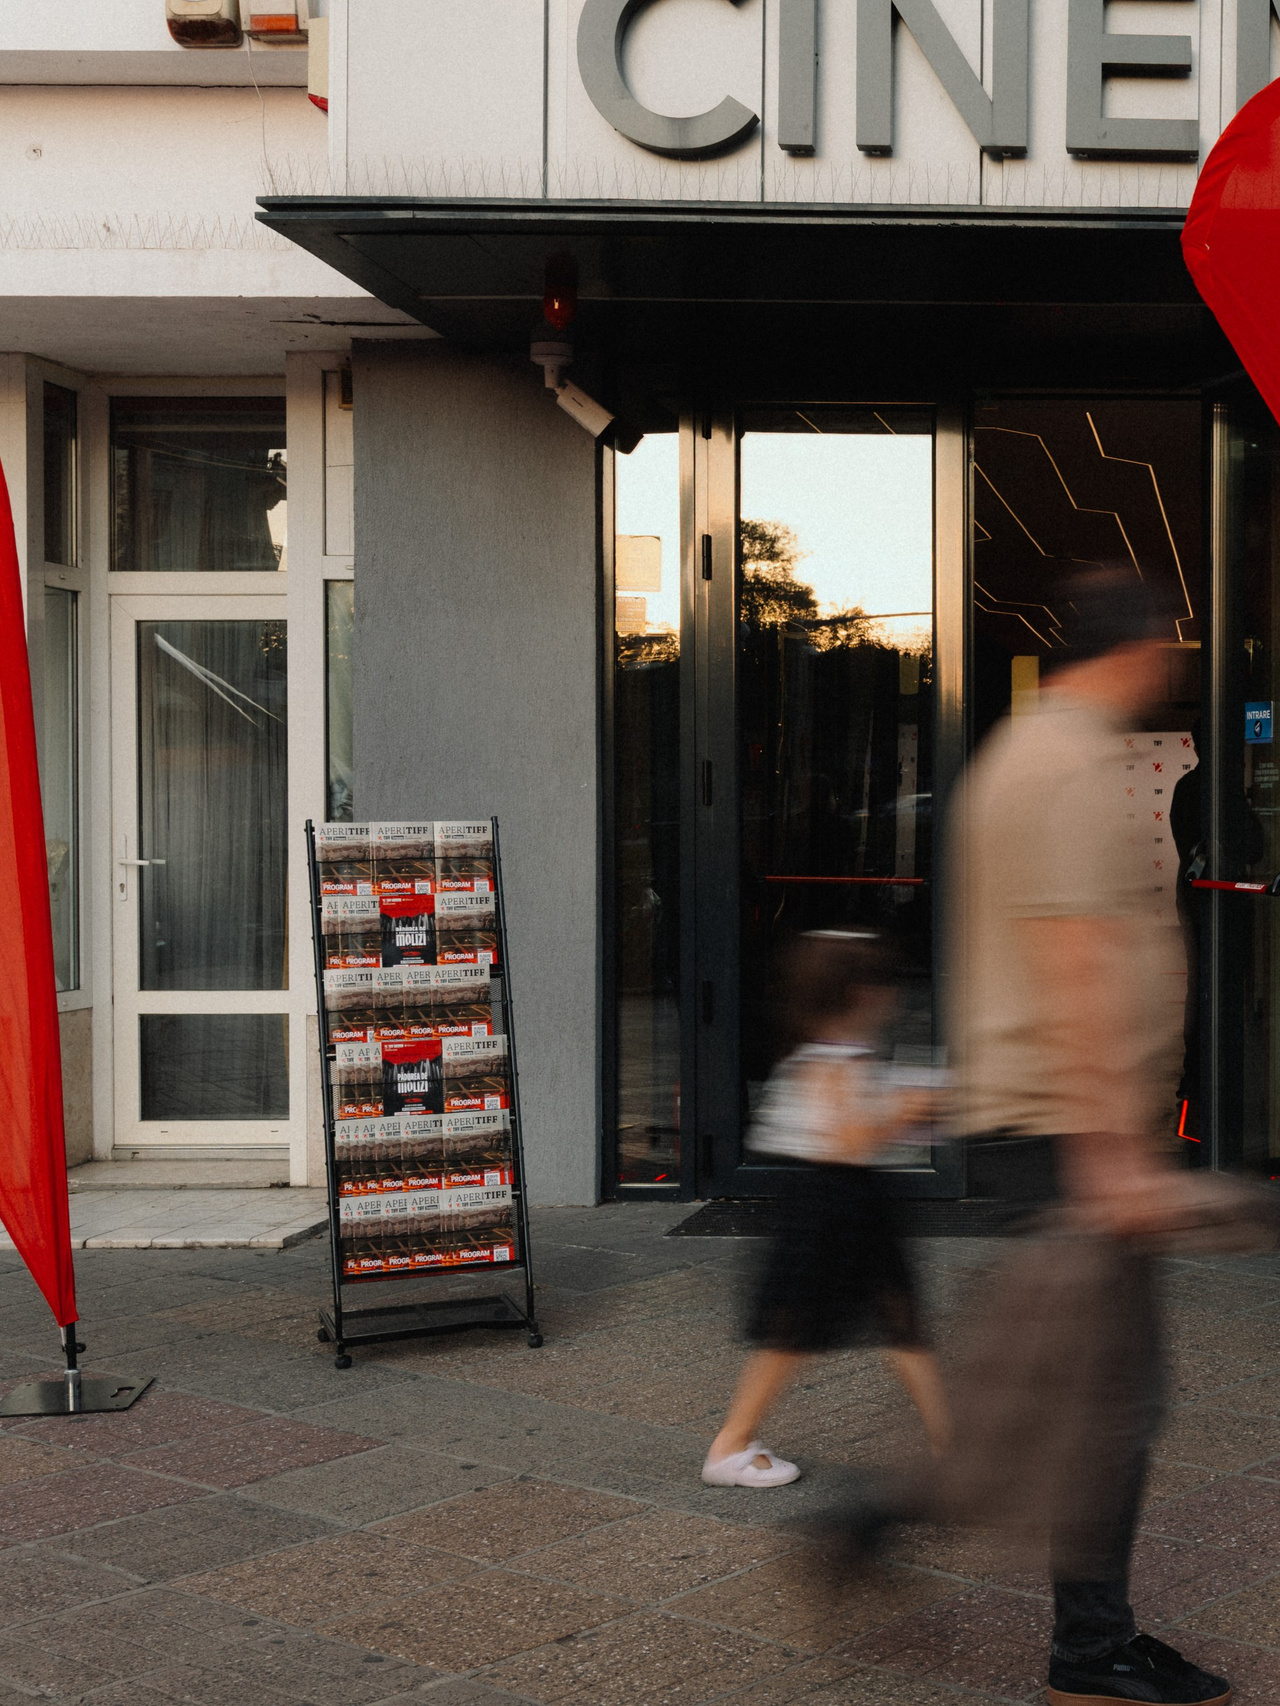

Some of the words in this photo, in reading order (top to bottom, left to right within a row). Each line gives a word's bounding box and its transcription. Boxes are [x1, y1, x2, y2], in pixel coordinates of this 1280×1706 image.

[1246, 709, 1271, 720] INTRARE
[378, 826, 428, 835] APERITIFF
[439, 826, 488, 834] APERITIFF
[342, 900, 380, 909] APERIT
[441, 897, 490, 906] APERITIFF
[396, 934, 427, 946] MOLIZI
[435, 969, 485, 979] APERITIFF
[411, 1027, 433, 1035] PROGR
[446, 1041, 498, 1051] APERITIFF
[450, 1099, 481, 1107] PROGRAM
[447, 1116, 498, 1126] APERITIFF
[409, 1178, 438, 1186] PROGRAM
[456, 1191, 507, 1202] APERITIFF
[460, 1250, 490, 1258] PROGRAM
[361, 1260, 383, 1268] PROGR
